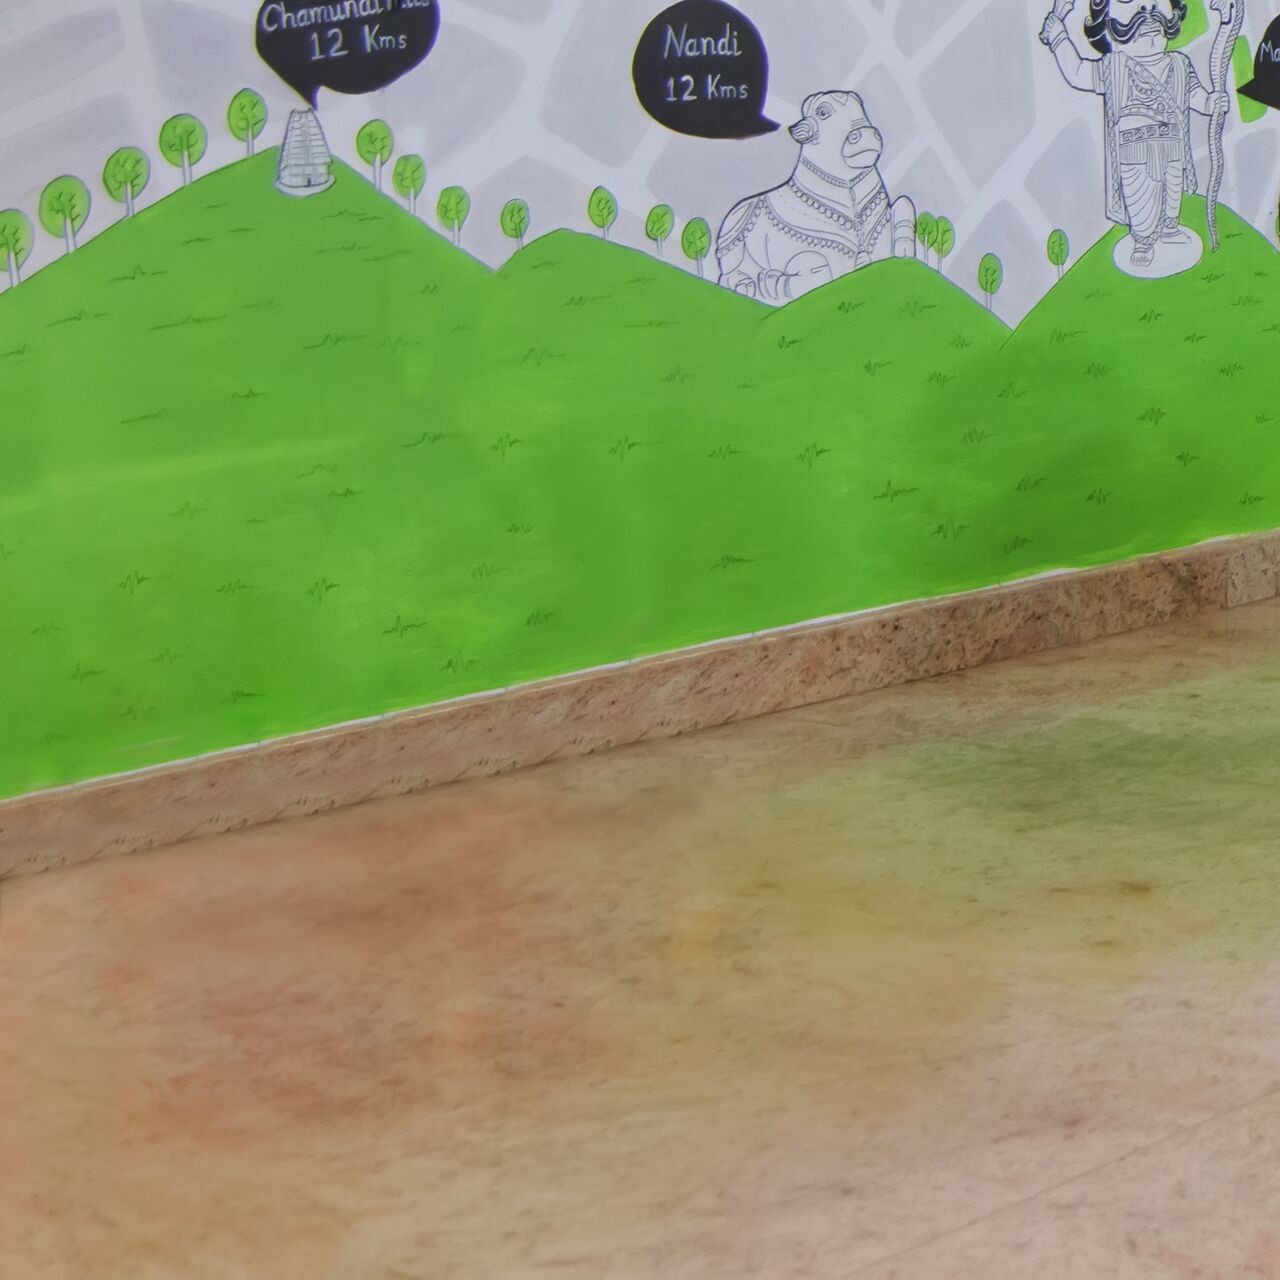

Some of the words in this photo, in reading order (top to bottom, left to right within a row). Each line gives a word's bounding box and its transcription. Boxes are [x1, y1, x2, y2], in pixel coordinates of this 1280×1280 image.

[311, 28, 349, 60] 12
[363, 24, 407, 53] Kms
[664, 23, 744, 58] Nandi
[666, 76, 697, 101] 12
[707, 73, 749, 100] Kms
